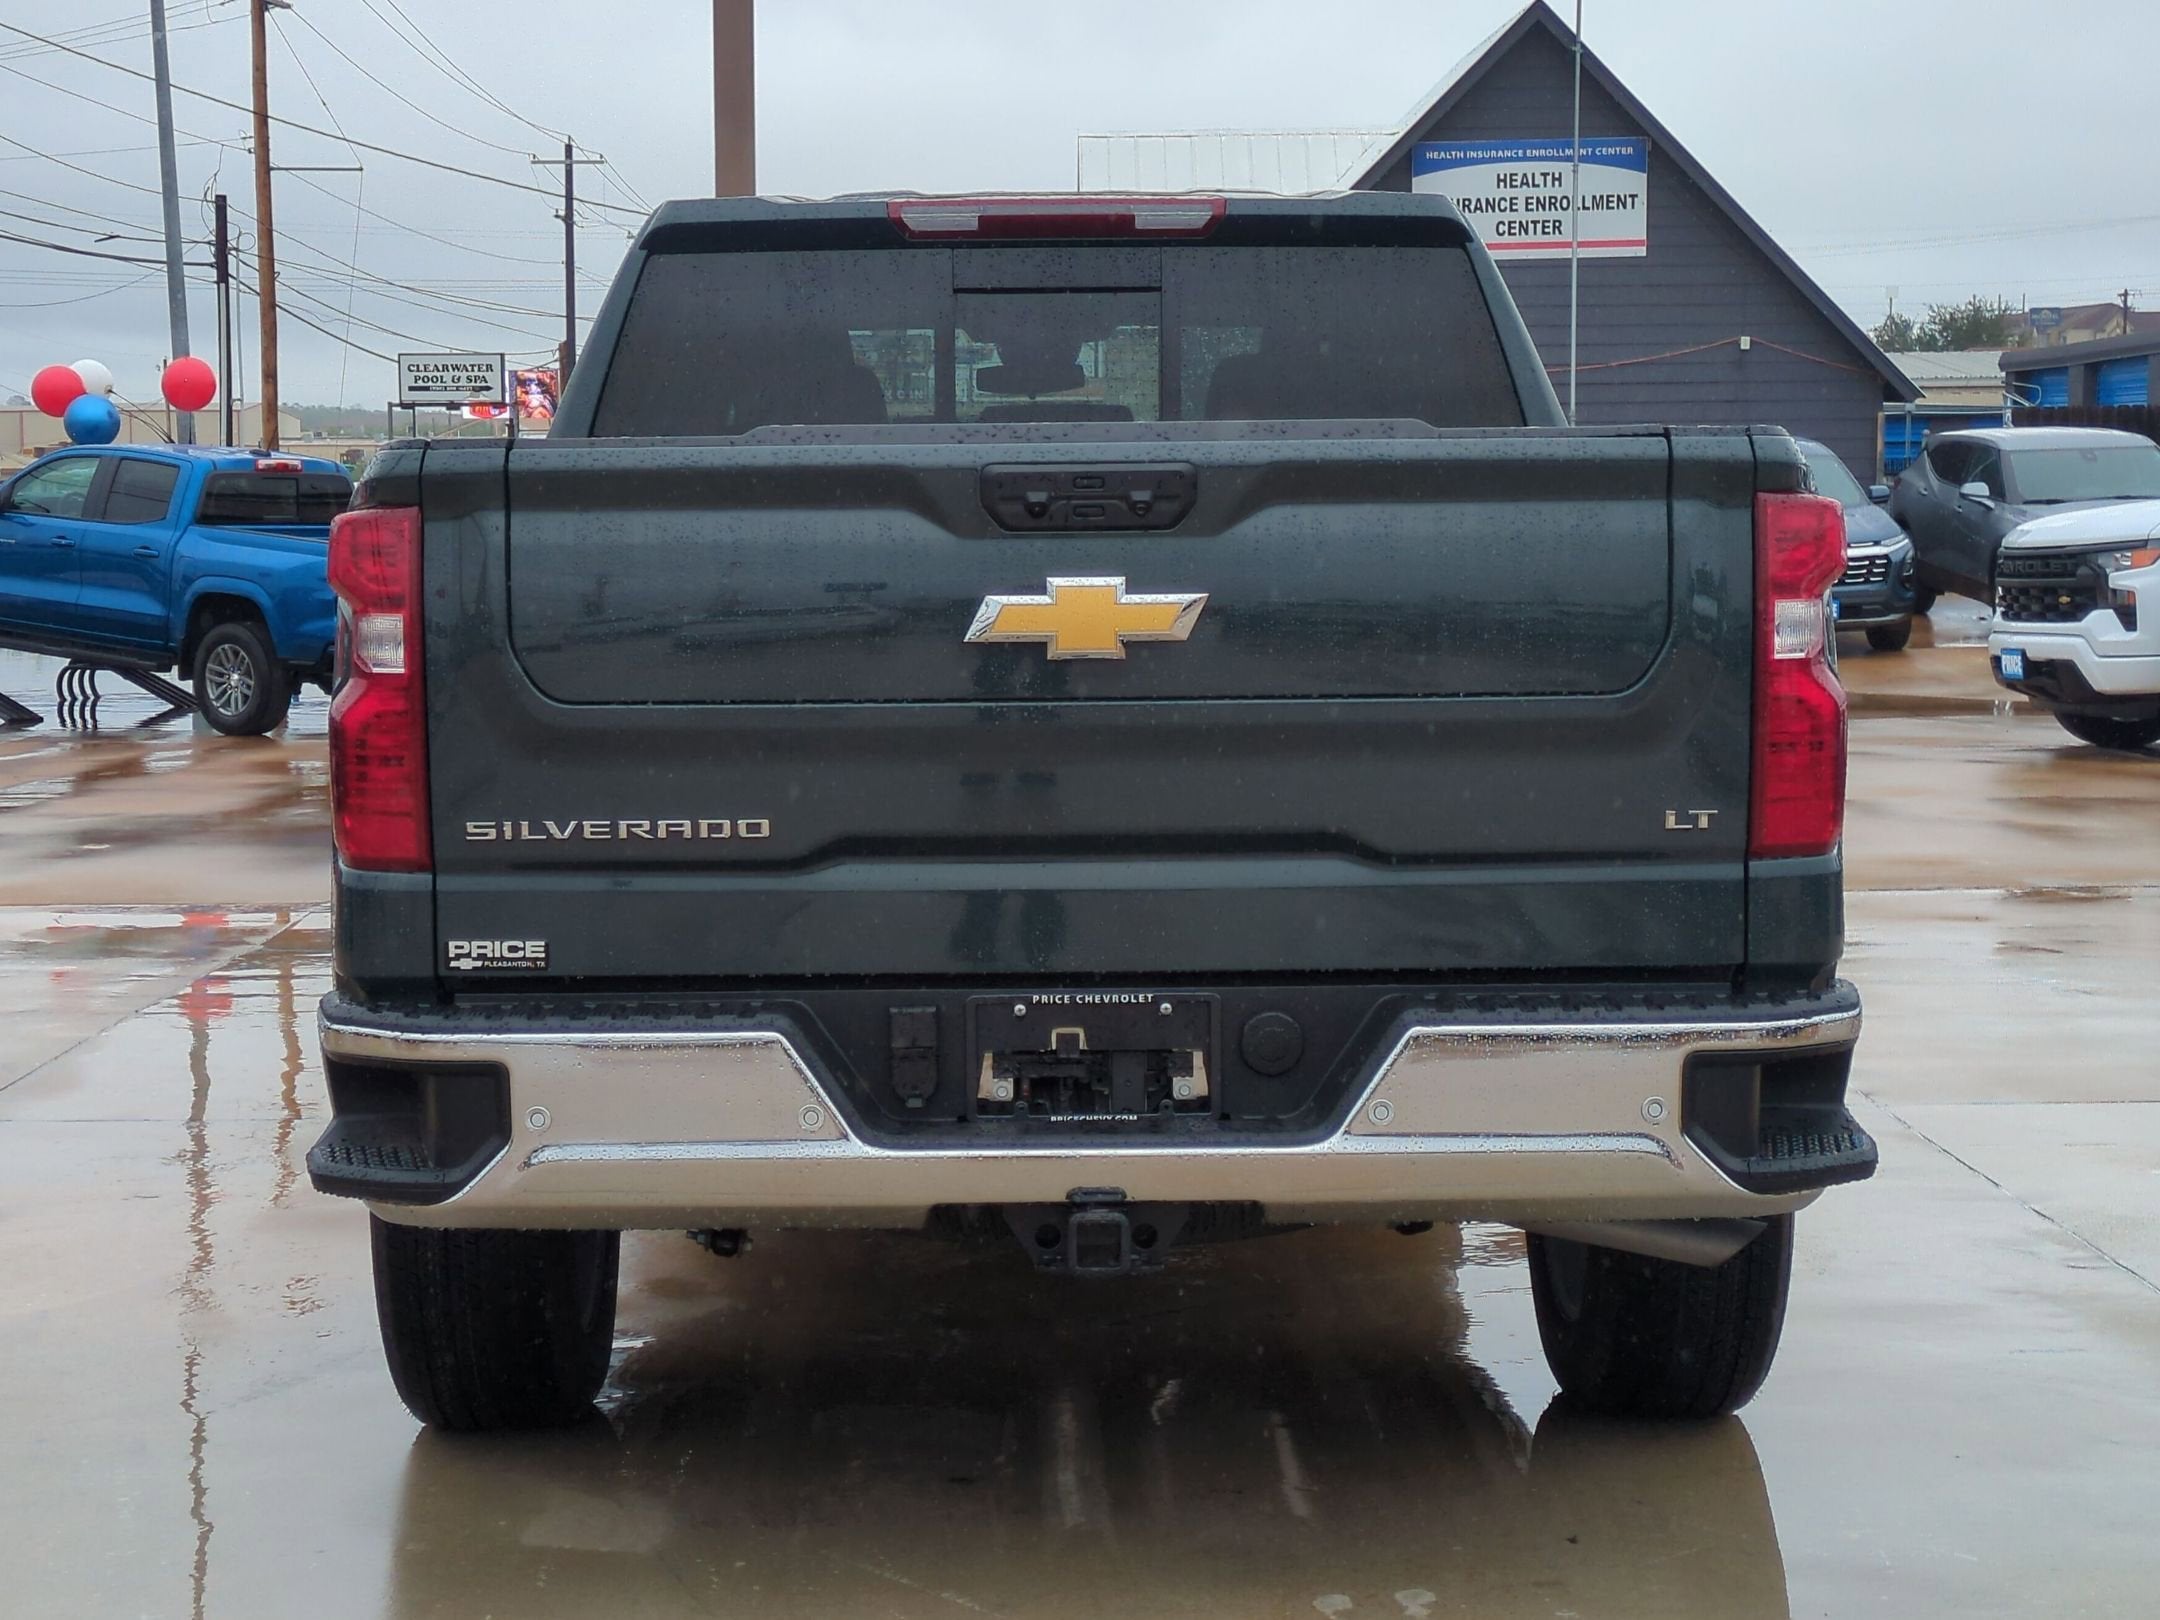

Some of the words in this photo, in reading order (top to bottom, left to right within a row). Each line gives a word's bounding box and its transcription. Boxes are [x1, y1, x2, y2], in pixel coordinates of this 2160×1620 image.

[1426, 151, 1464, 160] HEALTH
[1466, 149, 1524, 159] INSURANCE
[1526, 148, 1593, 157] ENROLLMNT
[1595, 146, 1634, 156] CENTER
[1496, 171, 1563, 189] HEALTH
[1524, 193, 1639, 212] ENROLMENT
[1495, 219, 1563, 237] CENTER
[407, 363, 494, 373] CLEARWATER
[413, 375, 447, 384] POOL
[451, 375, 461, 384] &
[465, 375, 489, 384] SPA
[1665, 810, 1719, 829] LT
[465, 819, 770, 841] SILVERADO
[448, 940, 546, 958] PRICE
[1032, 994, 1071, 1005] PRICE
[1075, 993, 1155, 1004] CHEVROLET
